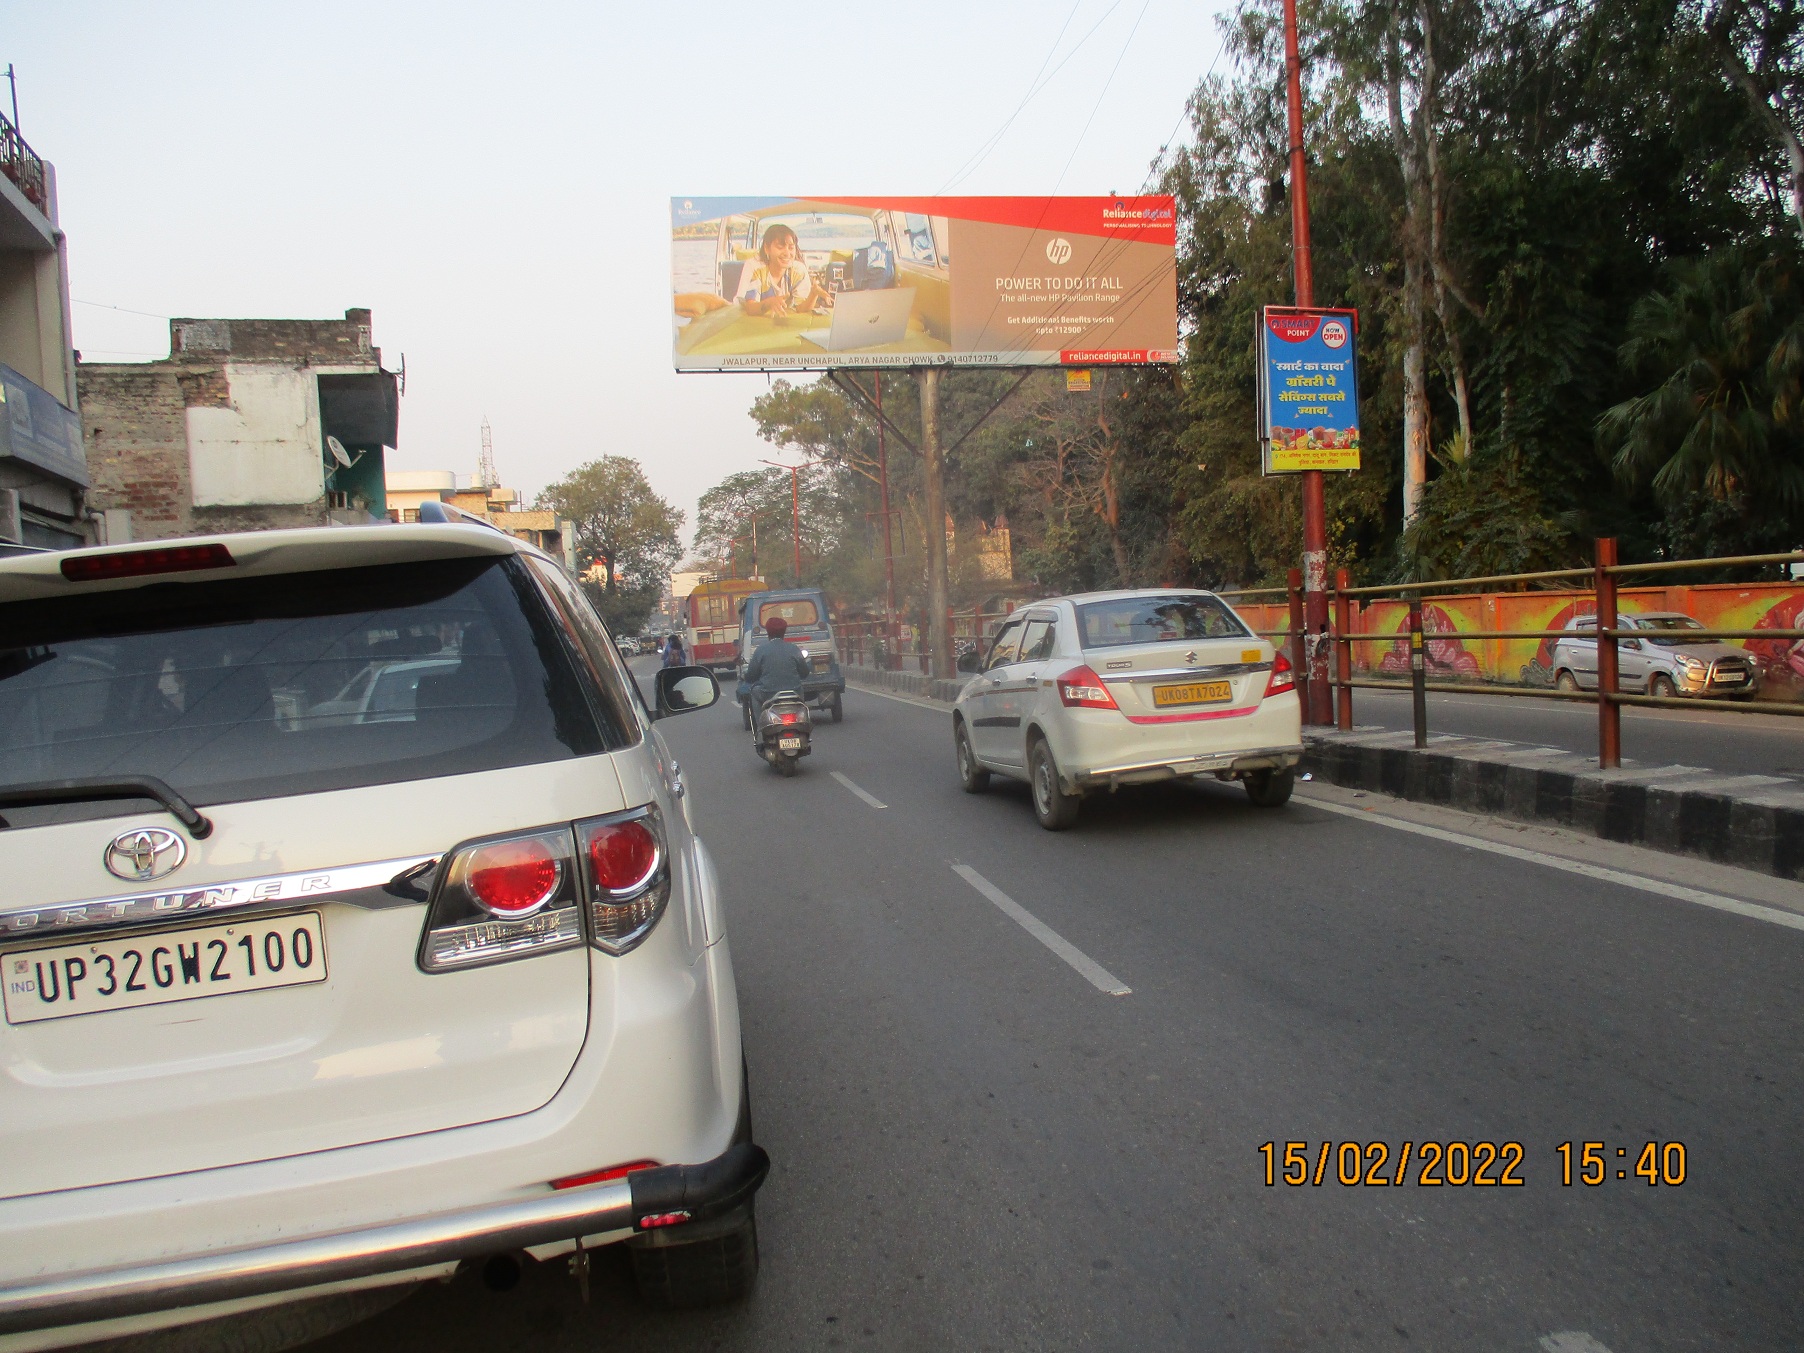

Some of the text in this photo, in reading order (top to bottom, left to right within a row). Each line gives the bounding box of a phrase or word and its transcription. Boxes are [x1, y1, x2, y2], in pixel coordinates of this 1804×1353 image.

[996, 277, 1124, 290] POWER TO DO IT ALL
[1001, 294, 1015, 302] The
[1017, 293, 1047, 302] all-new
[1062, 293, 1094, 302] Pavilion
[1096, 293, 1121, 303] Range
[1007, 316, 1020, 324] Get
[1282, 320, 1315, 328] SMART
[849, 356, 870, 364] ARYA
[872, 356, 900, 364] NAGAR
[1069, 351, 1141, 362] reliancedigital.in
[1276, 360, 1344, 371] स्मार्ट का वादा
[1326, 373, 1336, 387] पे
[1318, 390, 1345, 402] सबसे
[1161, 686, 1229, 701] UK08TA7024
[36, 927, 313, 1003] UP32GW2100
[11, 980, 35, 994] IND
